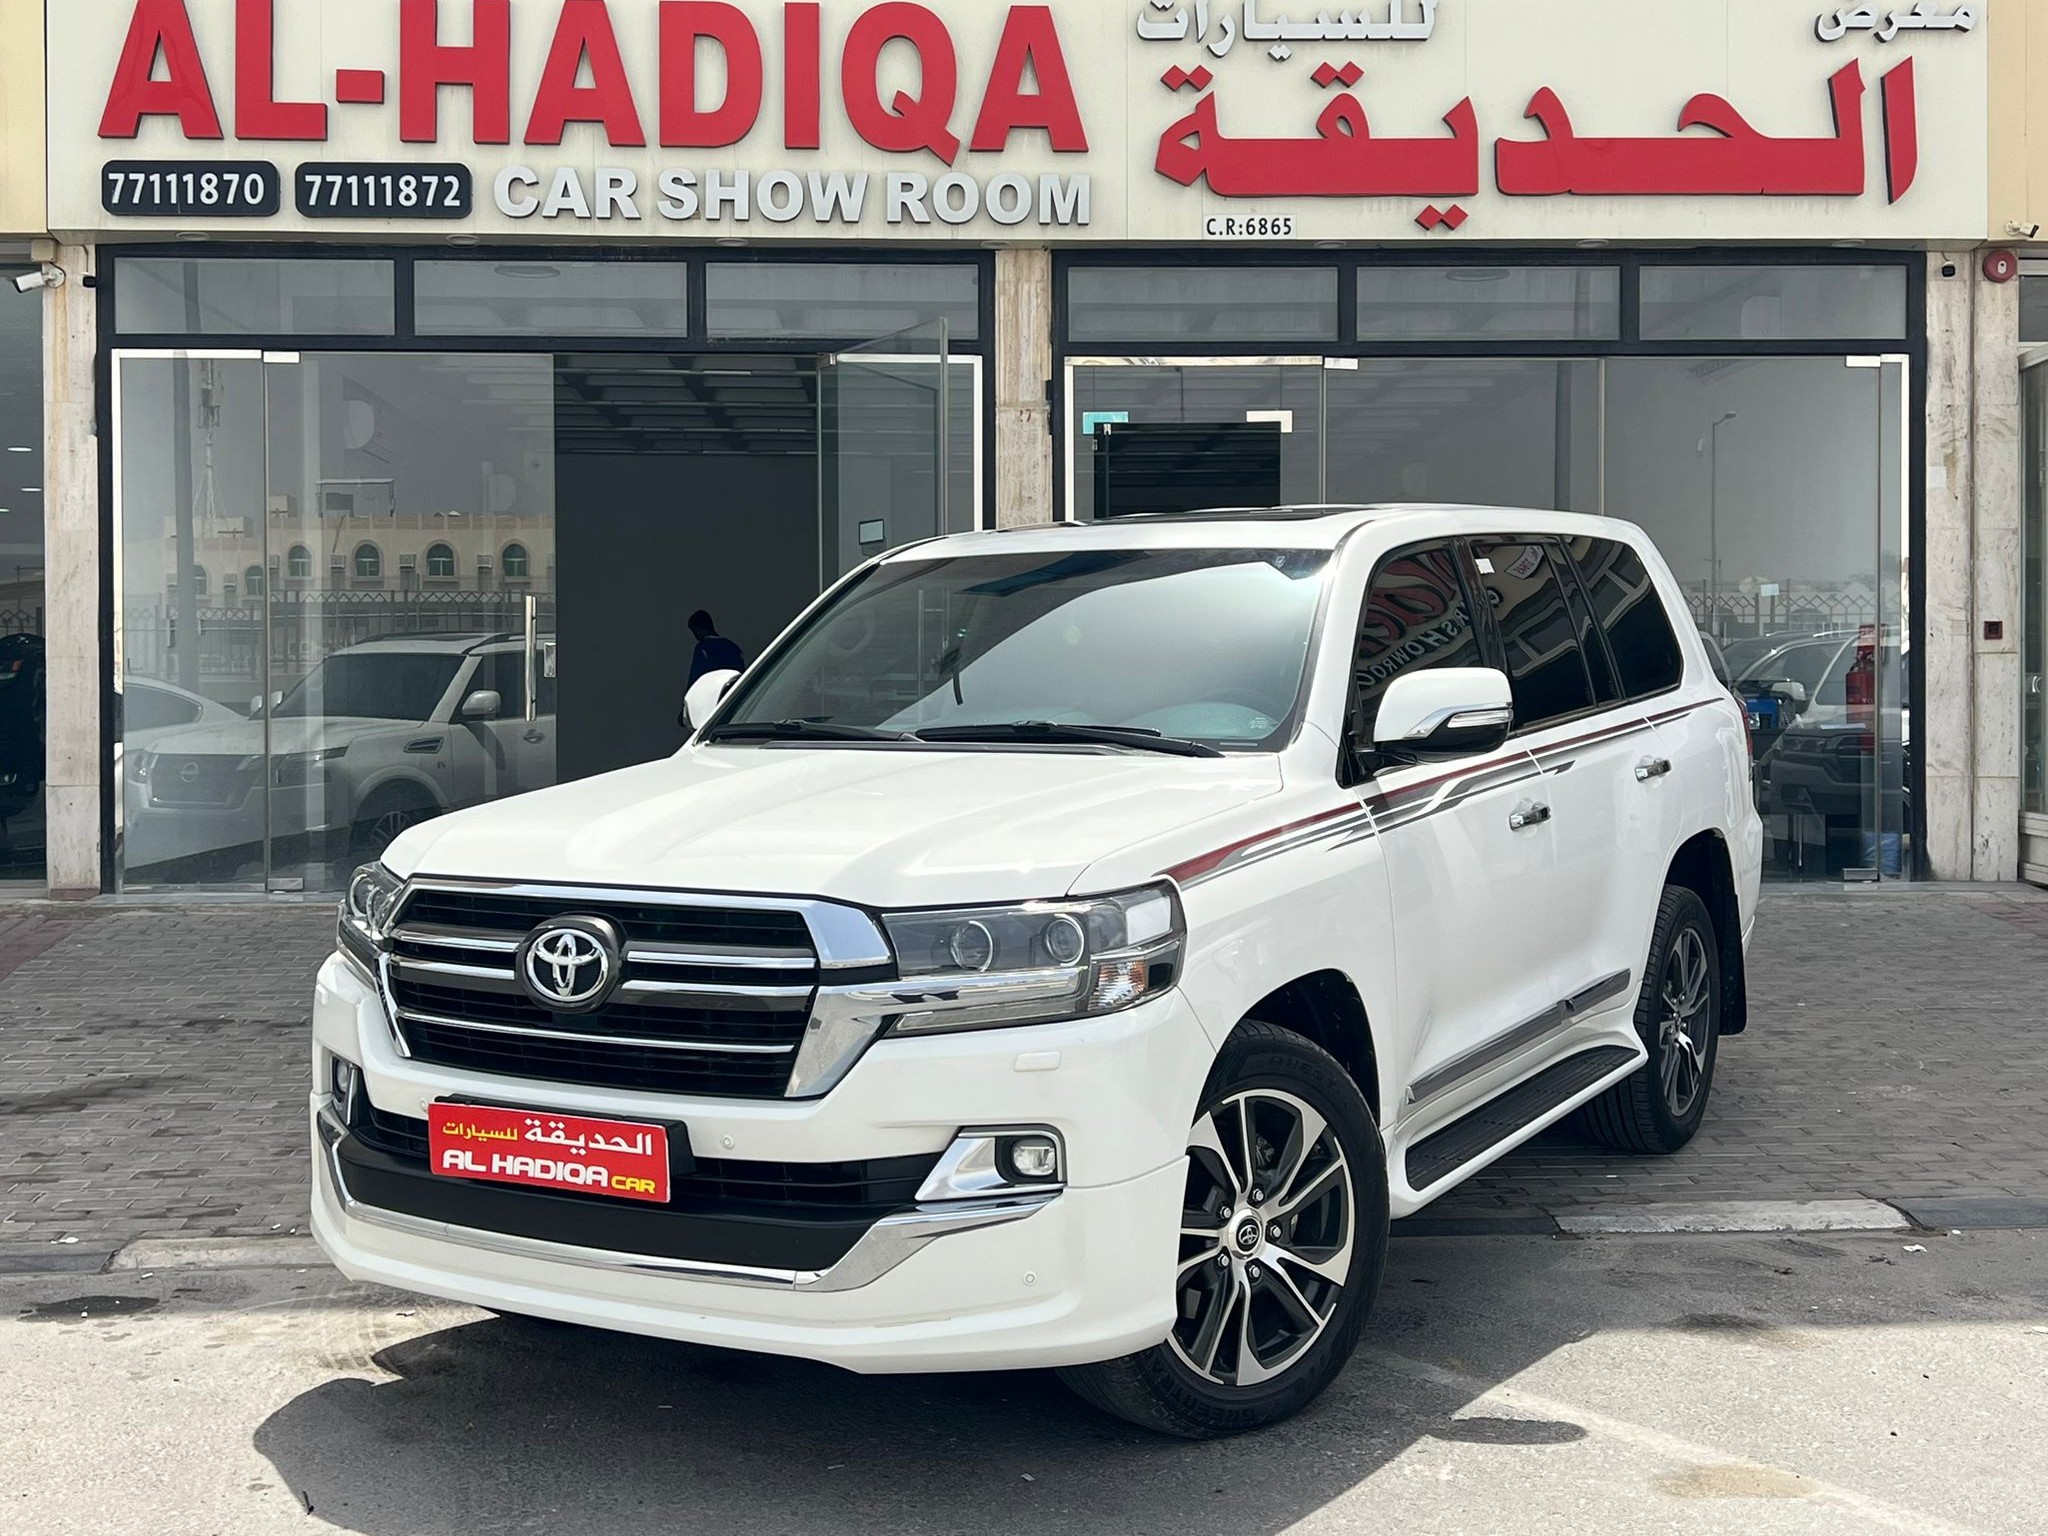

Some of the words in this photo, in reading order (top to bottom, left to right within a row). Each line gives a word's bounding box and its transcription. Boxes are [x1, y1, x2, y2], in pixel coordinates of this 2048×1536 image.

[98, 0, 1089, 165] AL-HADIQA
[1155, 57, 1918, 230] الحديقة
[107, 172, 265, 206] 77111870
[304, 174, 461, 208] 77111872
[492, 165, 641, 220] CAR
[657, 168, 869, 224] SHOW
[886, 172, 1091, 226] ROOM
[1205, 217, 1293, 236] C.R:6865
[442, 1121, 518, 1142] للسيارات
[524, 1118, 653, 1157] الحديقة
[442, 1148, 487, 1173] AL
[491, 1154, 609, 1188] HADIQA
[610, 1175, 656, 1195] CAR
